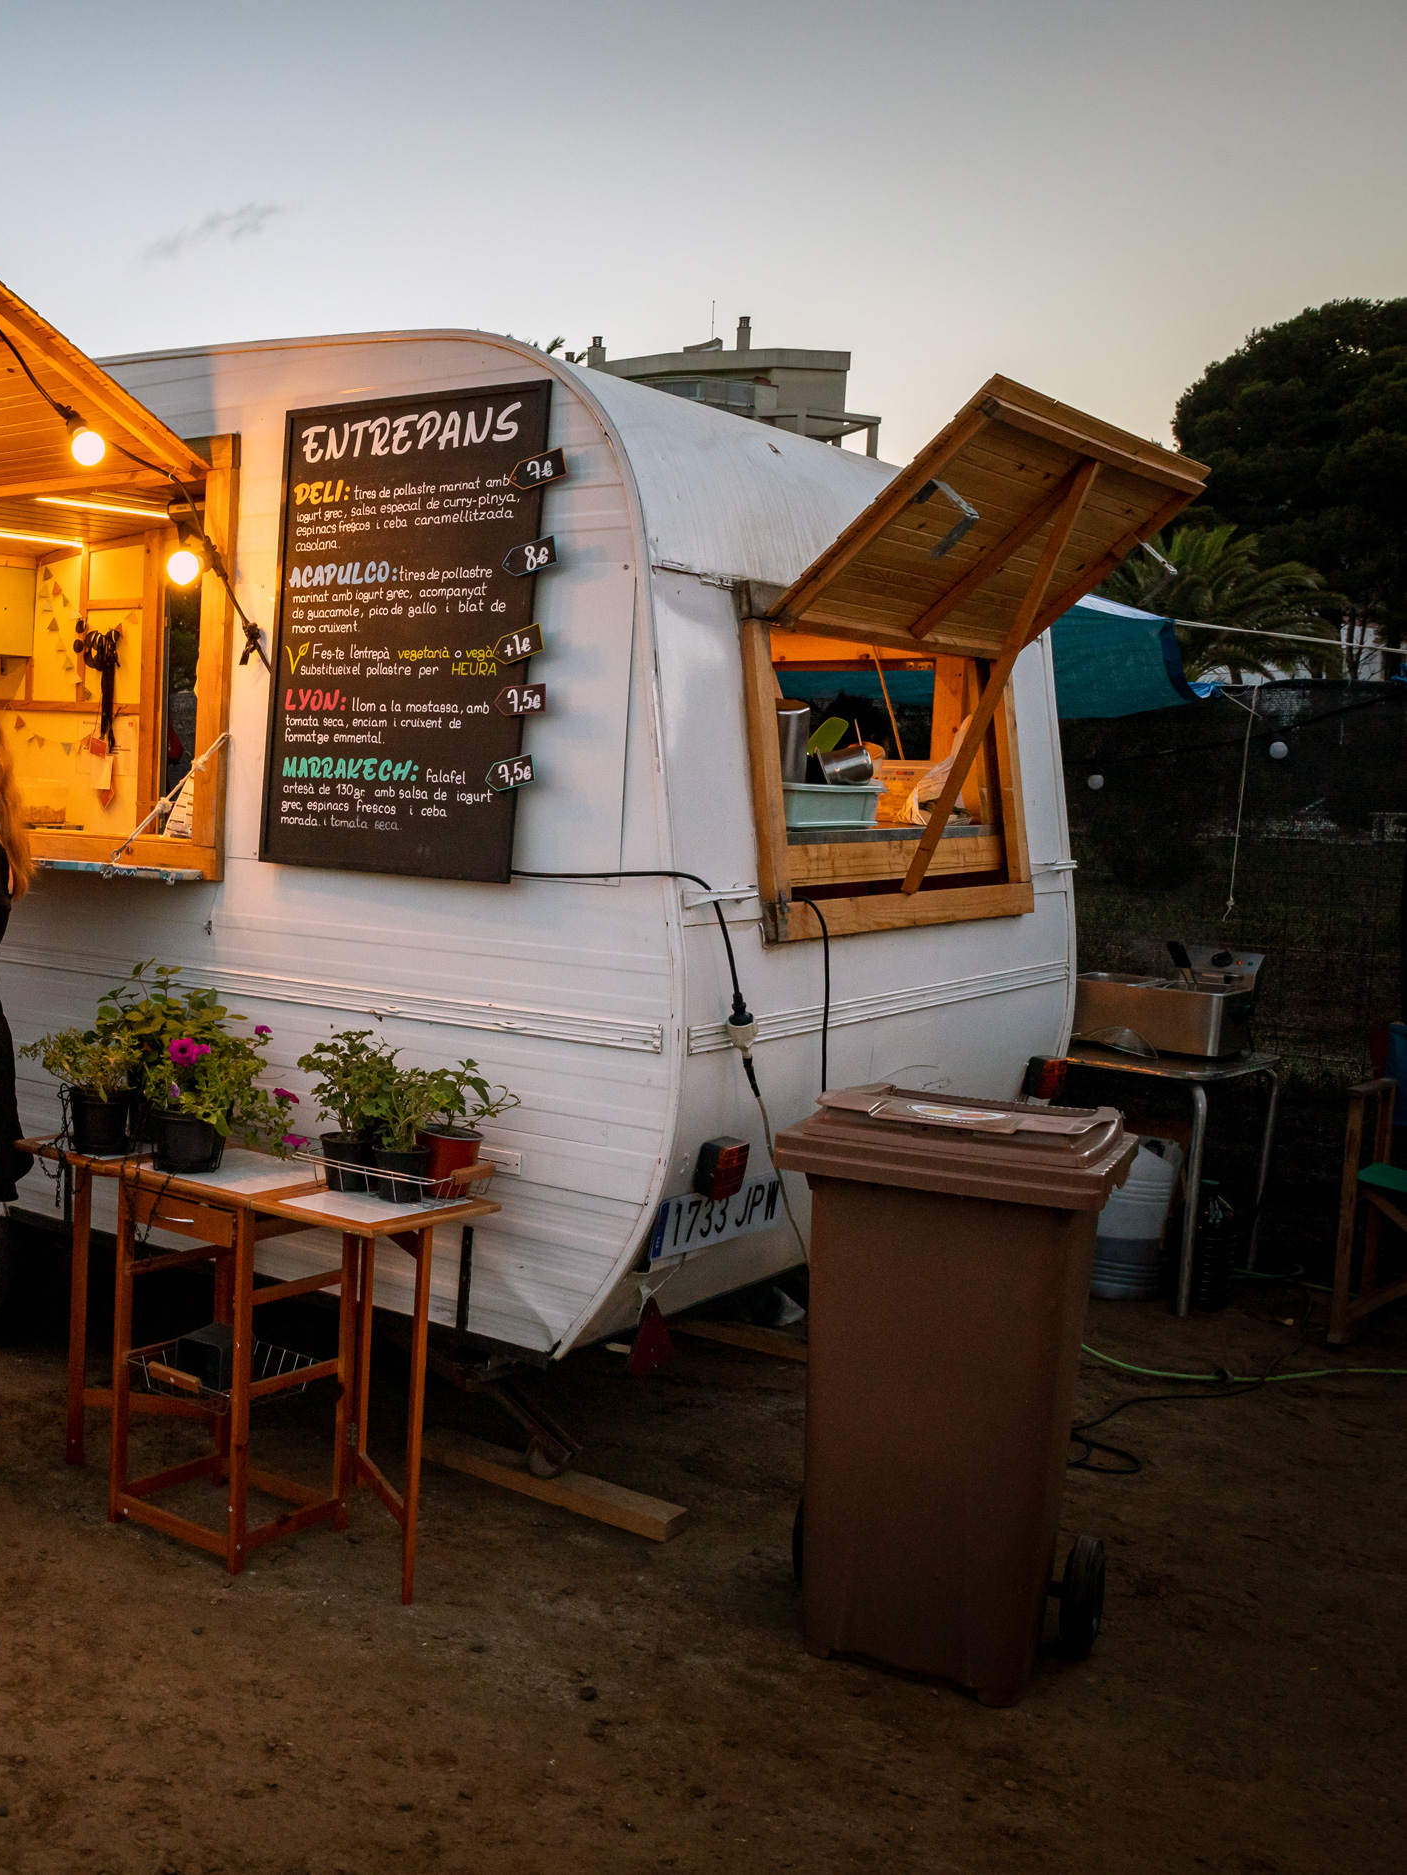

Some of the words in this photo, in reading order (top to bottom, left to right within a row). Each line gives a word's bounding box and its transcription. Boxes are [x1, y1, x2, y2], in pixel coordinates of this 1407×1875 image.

[300, 401, 523, 464] ENTREPANS
[527, 460, 553, 479] 7€
[294, 479, 351, 505] DELI:
[353, 485, 377, 500] tires
[379, 486, 391, 499] de
[393, 481, 436, 498] pollastre
[439, 477, 480, 493] marinat
[486, 474, 510, 487] amb
[296, 511, 323, 523] iogurt
[324, 508, 348, 520] grec,
[351, 503, 376, 517] salsa
[380, 498, 421, 515] especial
[426, 499, 440, 510] de
[443, 492, 520, 509] curry-pinya,
[296, 523, 337, 538] espinacs
[338, 521, 371, 533] frescos
[376, 520, 380, 530] i
[383, 518, 407, 529] ceba
[295, 539, 341, 552] casolana.
[524, 545, 548, 571] 8€
[289, 561, 398, 588] ACAPULCO:
[399, 565, 425, 582] tires
[427, 567, 440, 580] de
[441, 565, 493, 583] pollastre
[293, 590, 329, 603] marinat
[332, 589, 353, 601] amb
[355, 588, 383, 601] iogurt
[386, 590, 413, 605] grec,
[419, 582, 488, 602] acompanyat
[292, 608, 304, 619] de
[307, 605, 364, 621] guacamole,
[369, 606, 388, 618] pico
[391, 604, 403, 615] de
[408, 602, 437, 617] gallo
[446, 603, 449, 613] i
[458, 600, 484, 613] blat
[490, 600, 506, 612] de
[292, 624, 316, 634] moro
[319, 620, 360, 633] cruixent.
[312, 643, 344, 660] Fes-te
[350, 644, 390, 661] l'entrepà
[398, 645, 450, 661] vegetarià
[454, 649, 462, 659] o
[466, 645, 494, 661] vegà
[504, 634, 531, 657] +1€
[366, 662, 411, 678] pollastre
[418, 665, 439, 678] per
[451, 661, 497, 676] HEURA
[285, 688, 346, 712] LYON:
[352, 697, 376, 712] llom
[379, 702, 387, 712] a
[391, 700, 402, 712] la
[406, 701, 464, 715] mostassa,
[466, 701, 489, 715] amb
[285, 715, 319, 727] tomata
[323, 717, 349, 729] seca,
[352, 718, 387, 728] enciam
[393, 718, 397, 727] i
[400, 717, 442, 729] cruixent
[449, 719, 462, 729] de
[285, 728, 329, 744] formatge
[333, 731, 385, 745] emmental.
[281, 755, 420, 782] MARRAKECH:
[425, 768, 466, 785] falafel
[283, 783, 315, 794] artesà
[319, 784, 331, 795] de
[375, 786, 395, 797] amb
[399, 787, 428, 800] salsa
[433, 789, 447, 801] de
[456, 788, 494, 805] iogurt
[280, 800, 303, 812] grec,
[307, 801, 349, 813] espinacs
[356, 799, 397, 815] frescos
[409, 805, 413, 815] i
[421, 806, 447, 817] ceba
[280, 815, 321, 827] morada.
[331, 816, 368, 829] tomata
[673, 1197, 729, 1246] 1733
[735, 1180, 780, 1227] JPW
